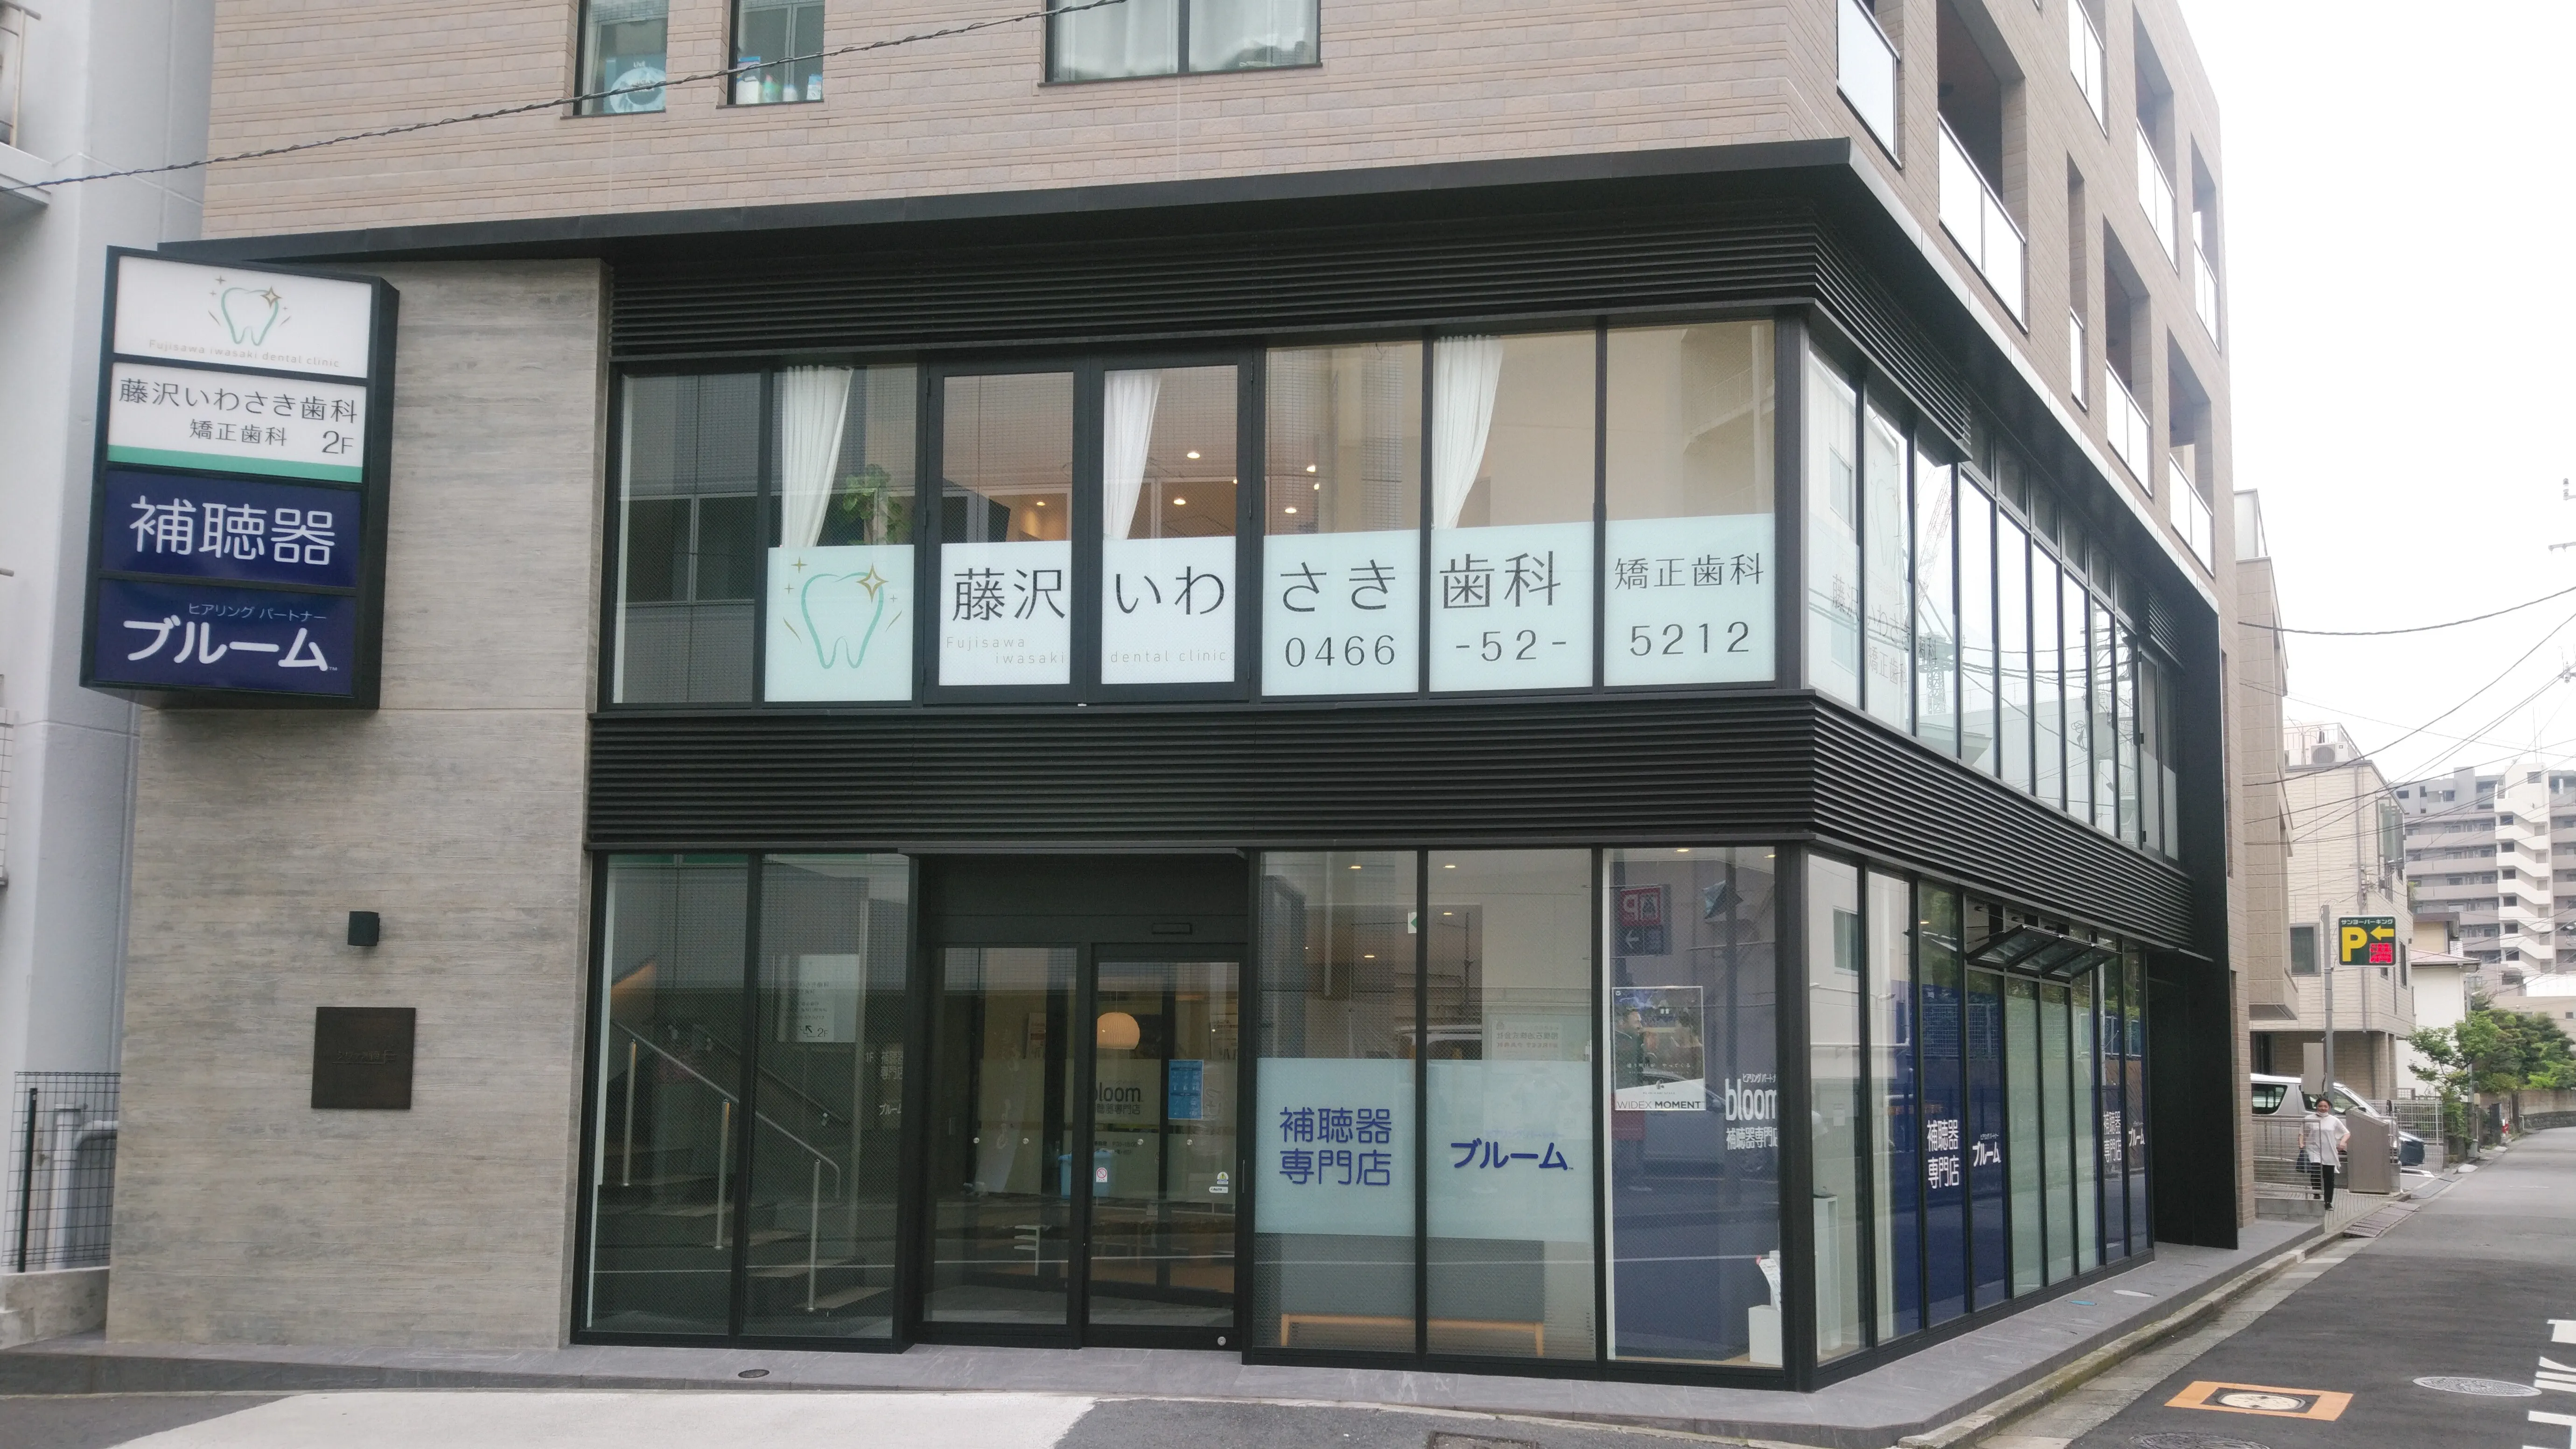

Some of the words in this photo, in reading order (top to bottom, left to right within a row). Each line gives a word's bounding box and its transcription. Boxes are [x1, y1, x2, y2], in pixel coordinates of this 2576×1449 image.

[149, 339, 205, 354] Fujisawa
[210, 348, 259, 359] iwasaki
[262, 351, 303, 364] dental
[307, 356, 339, 368] clinic
[119, 378, 357, 424] 藤沢いわさき歯科
[189, 418, 287, 446] 矯正歯科
[322, 430, 354, 455] 2F
[129, 495, 335, 566] 補聴器
[952, 567, 1066, 622] 藤沢
[1115, 565, 1225, 616] いわ
[1280, 559, 1396, 613] さき
[1439, 550, 1561, 609] 歯科
[1614, 552, 1764, 590] 矯正歯科
[188, 602, 255, 619] ヒアリング
[259, 607, 327, 623] パートナー
[123, 615, 329, 672] ブルーム
[946, 636, 1025, 651] Fujisawa
[995, 651, 1065, 665] iwasaki
[1110, 650, 1169, 663] dental
[1179, 649, 1227, 662] clinic
[1284, 635, 1395, 667] 0466
[1629, 621, 1750, 657] 5212
[2342, 927, 2367, 962] P
[1094, 1082, 1141, 1102] loom
[1279, 1106, 1392, 1144] 補聴器
[1927, 1119, 1959, 1152] 補聴器
[1279, 1148, 1392, 1186] 専門店
[1450, 1137, 1568, 1171] ブルーム
[1972, 1141, 2002, 1167] ブルーム
[1927, 1155, 1960, 1189] 専門店
